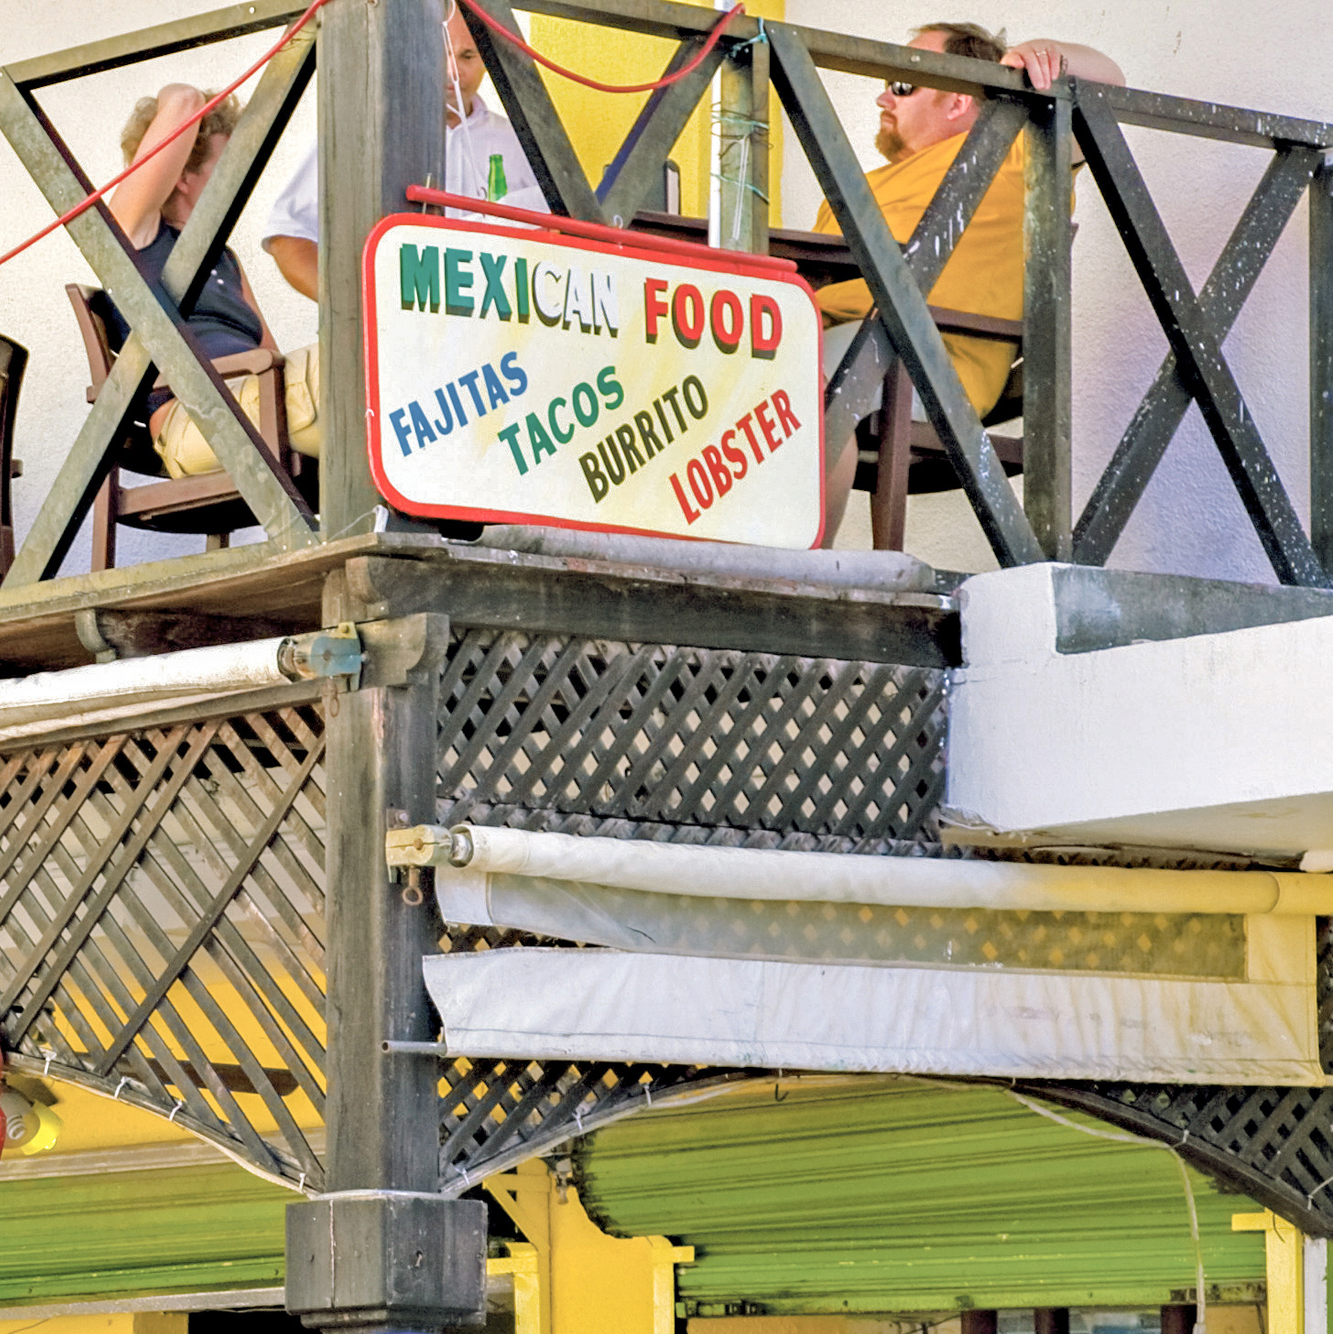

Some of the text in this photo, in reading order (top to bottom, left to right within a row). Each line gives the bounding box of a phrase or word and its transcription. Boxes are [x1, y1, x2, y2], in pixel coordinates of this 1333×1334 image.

[399, 243, 783, 358] MEXICAN FOOD
[388, 351, 529, 457] FAJITAS
[497, 365, 625, 476] TACOS
[578, 374, 709, 503] BURRITO
[668, 388, 801, 525] LOBSTER
